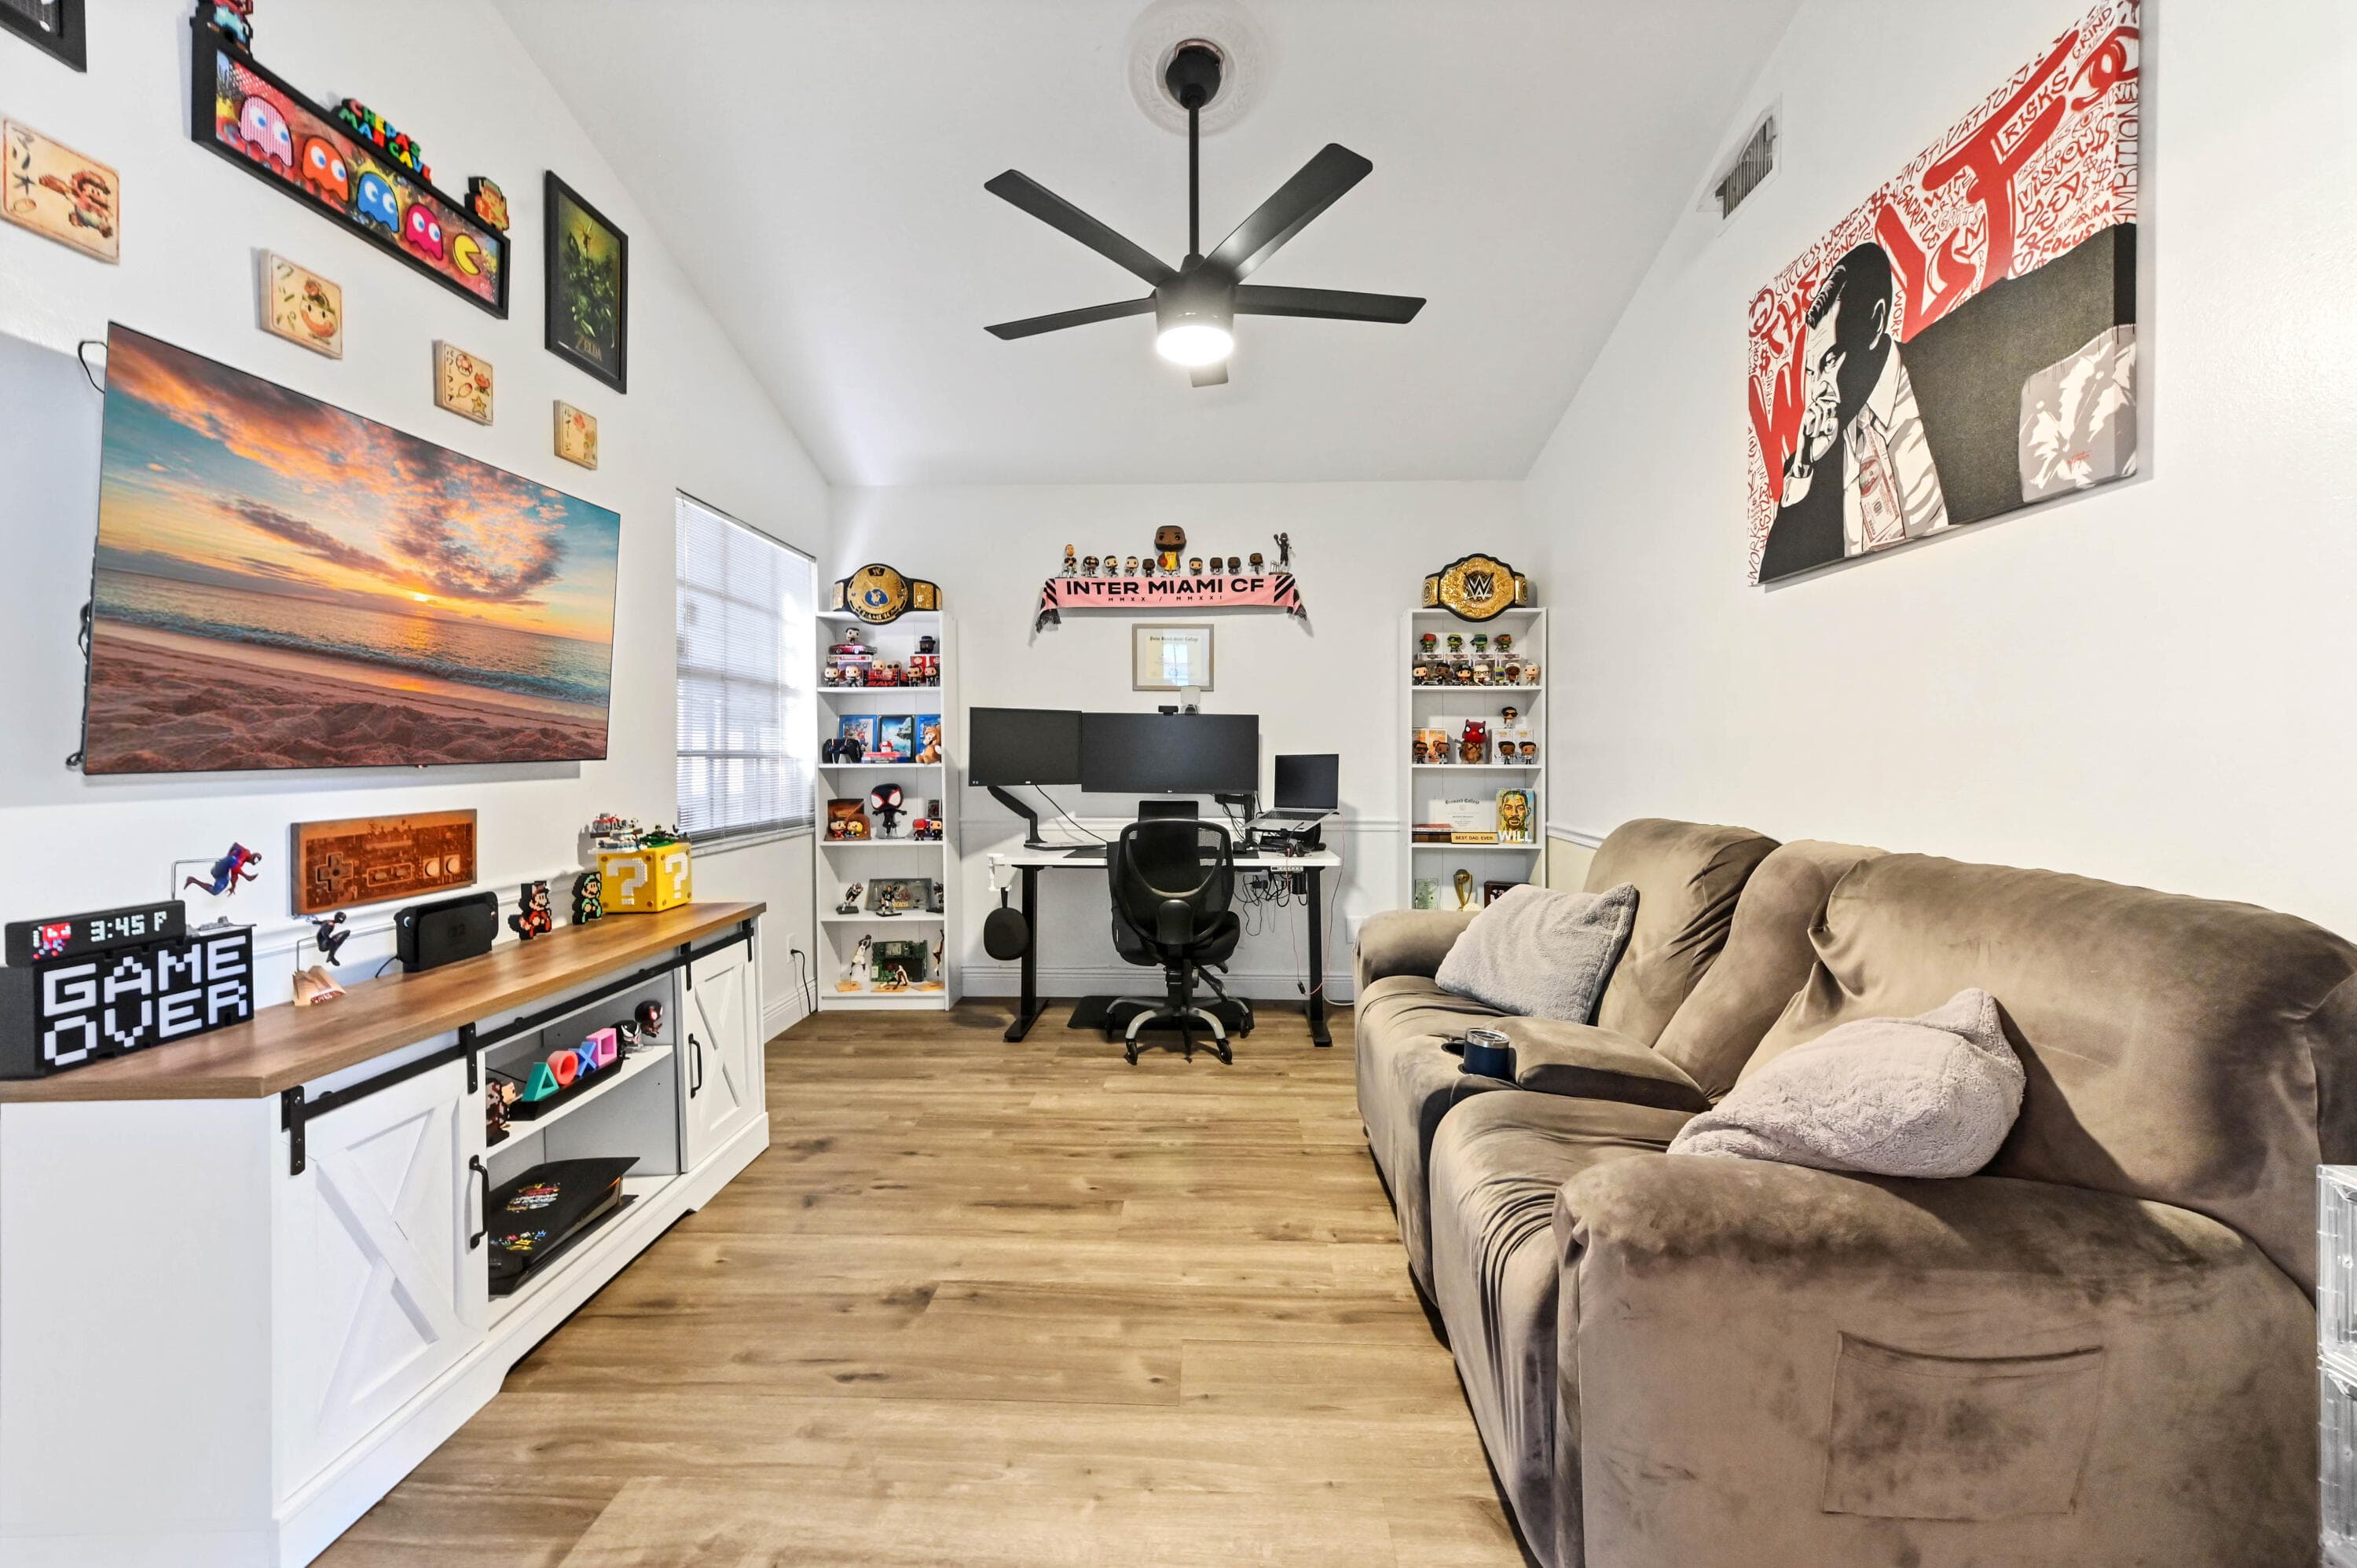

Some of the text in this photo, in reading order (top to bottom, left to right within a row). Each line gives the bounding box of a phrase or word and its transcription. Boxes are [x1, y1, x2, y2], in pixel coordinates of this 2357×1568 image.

[2072, 7, 2112, 59] GRIND
[339, 108, 384, 148] MAN
[1901, 66, 2029, 185] MOTIVATION
[2003, 66, 2069, 144] RISKS
[1925, 169, 1966, 207] WIN
[2053, 185, 2104, 237] DEDICATION
[1825, 214, 1871, 273] MONEY
[1897, 185, 1940, 250] SACRIFICE
[2043, 223, 2095, 255] FOCUS
[1775, 243, 1821, 303] SUCCESS
[1760, 258, 1821, 355] THE
[1891, 289, 1904, 337] WORK
[1750, 337, 1761, 374] WORK
[1759, 482, 1772, 550] HUSTLE
[1748, 528, 1761, 580] WORK
[1066, 578, 1264, 595] INTER MIAMI CF
[1497, 830, 1532, 842] WILL
[90, 914, 145, 943] 3:45
[43, 935, 247, 1017] GAME
[43, 979, 247, 1066] OVER
